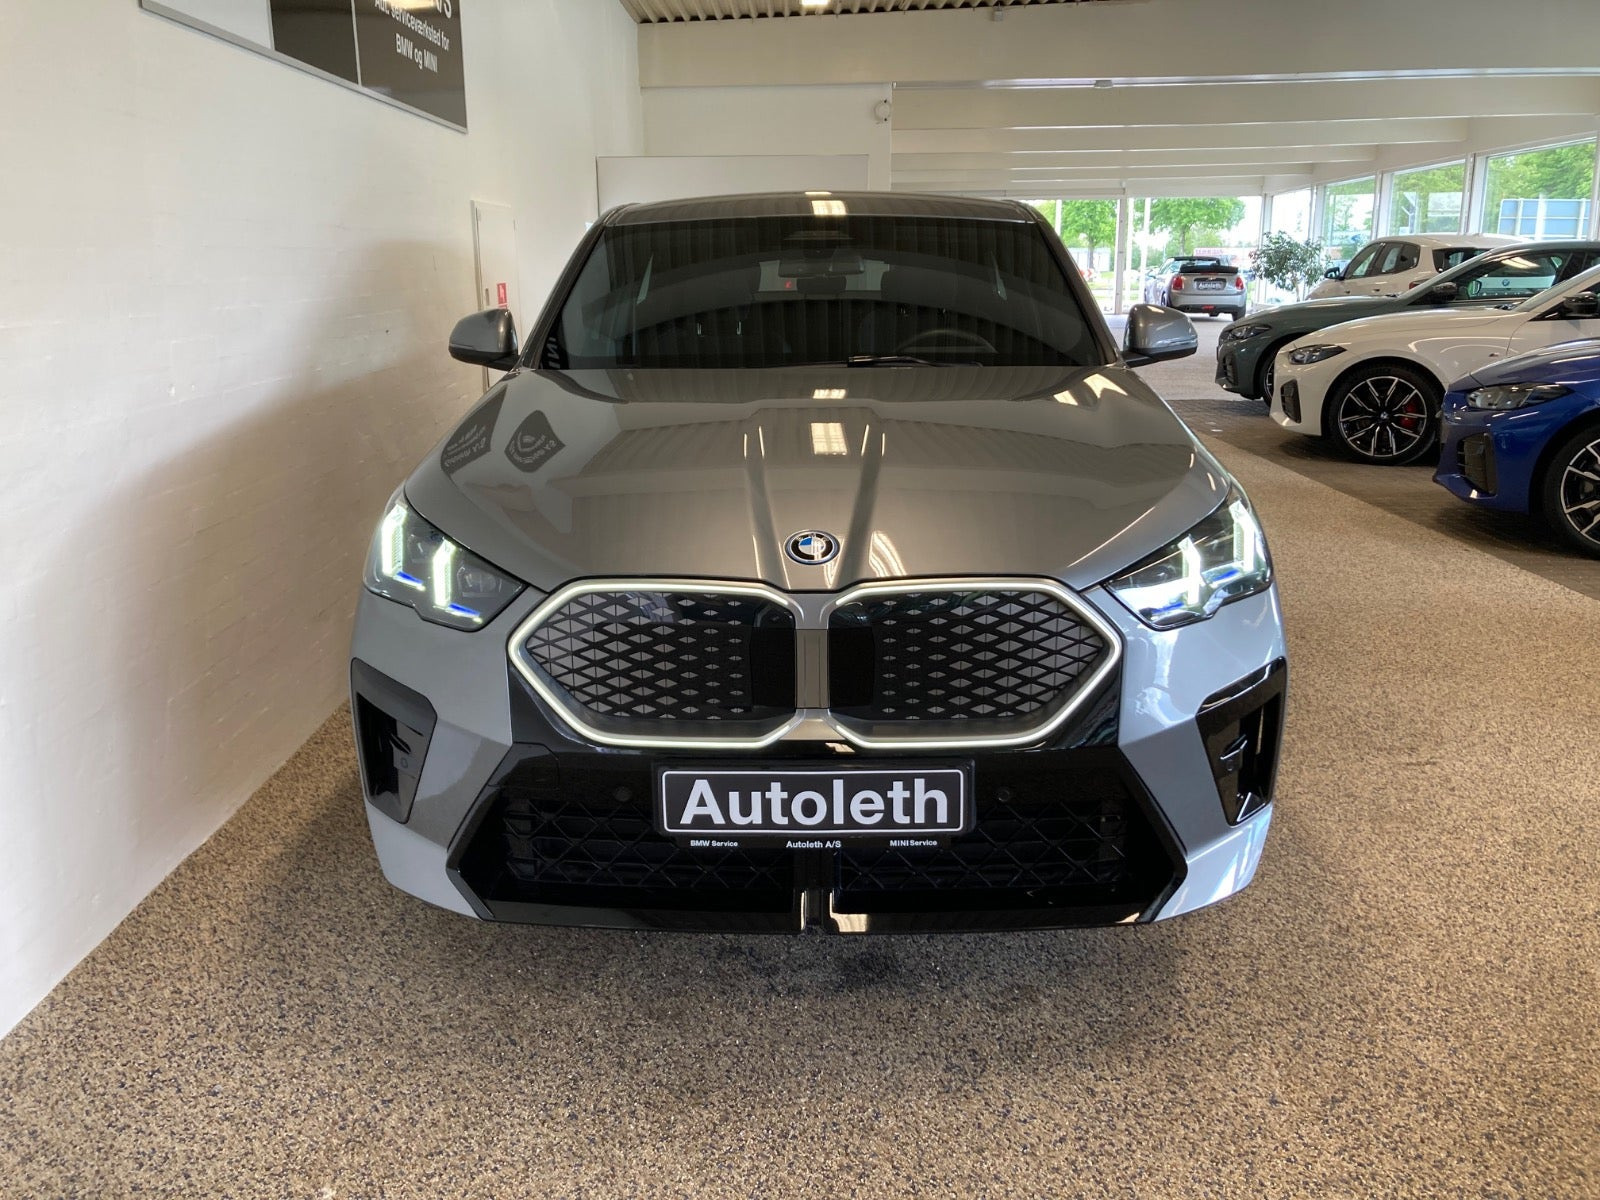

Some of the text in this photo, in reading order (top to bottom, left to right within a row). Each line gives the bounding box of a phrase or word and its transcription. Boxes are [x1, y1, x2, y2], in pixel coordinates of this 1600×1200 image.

[441, 31, 450, 52] for
[395, 32, 438, 73] BMW og MINI
[679, 778, 948, 825] Autoleth
[711, 840, 738, 848] Service
[910, 839, 938, 847] Service
